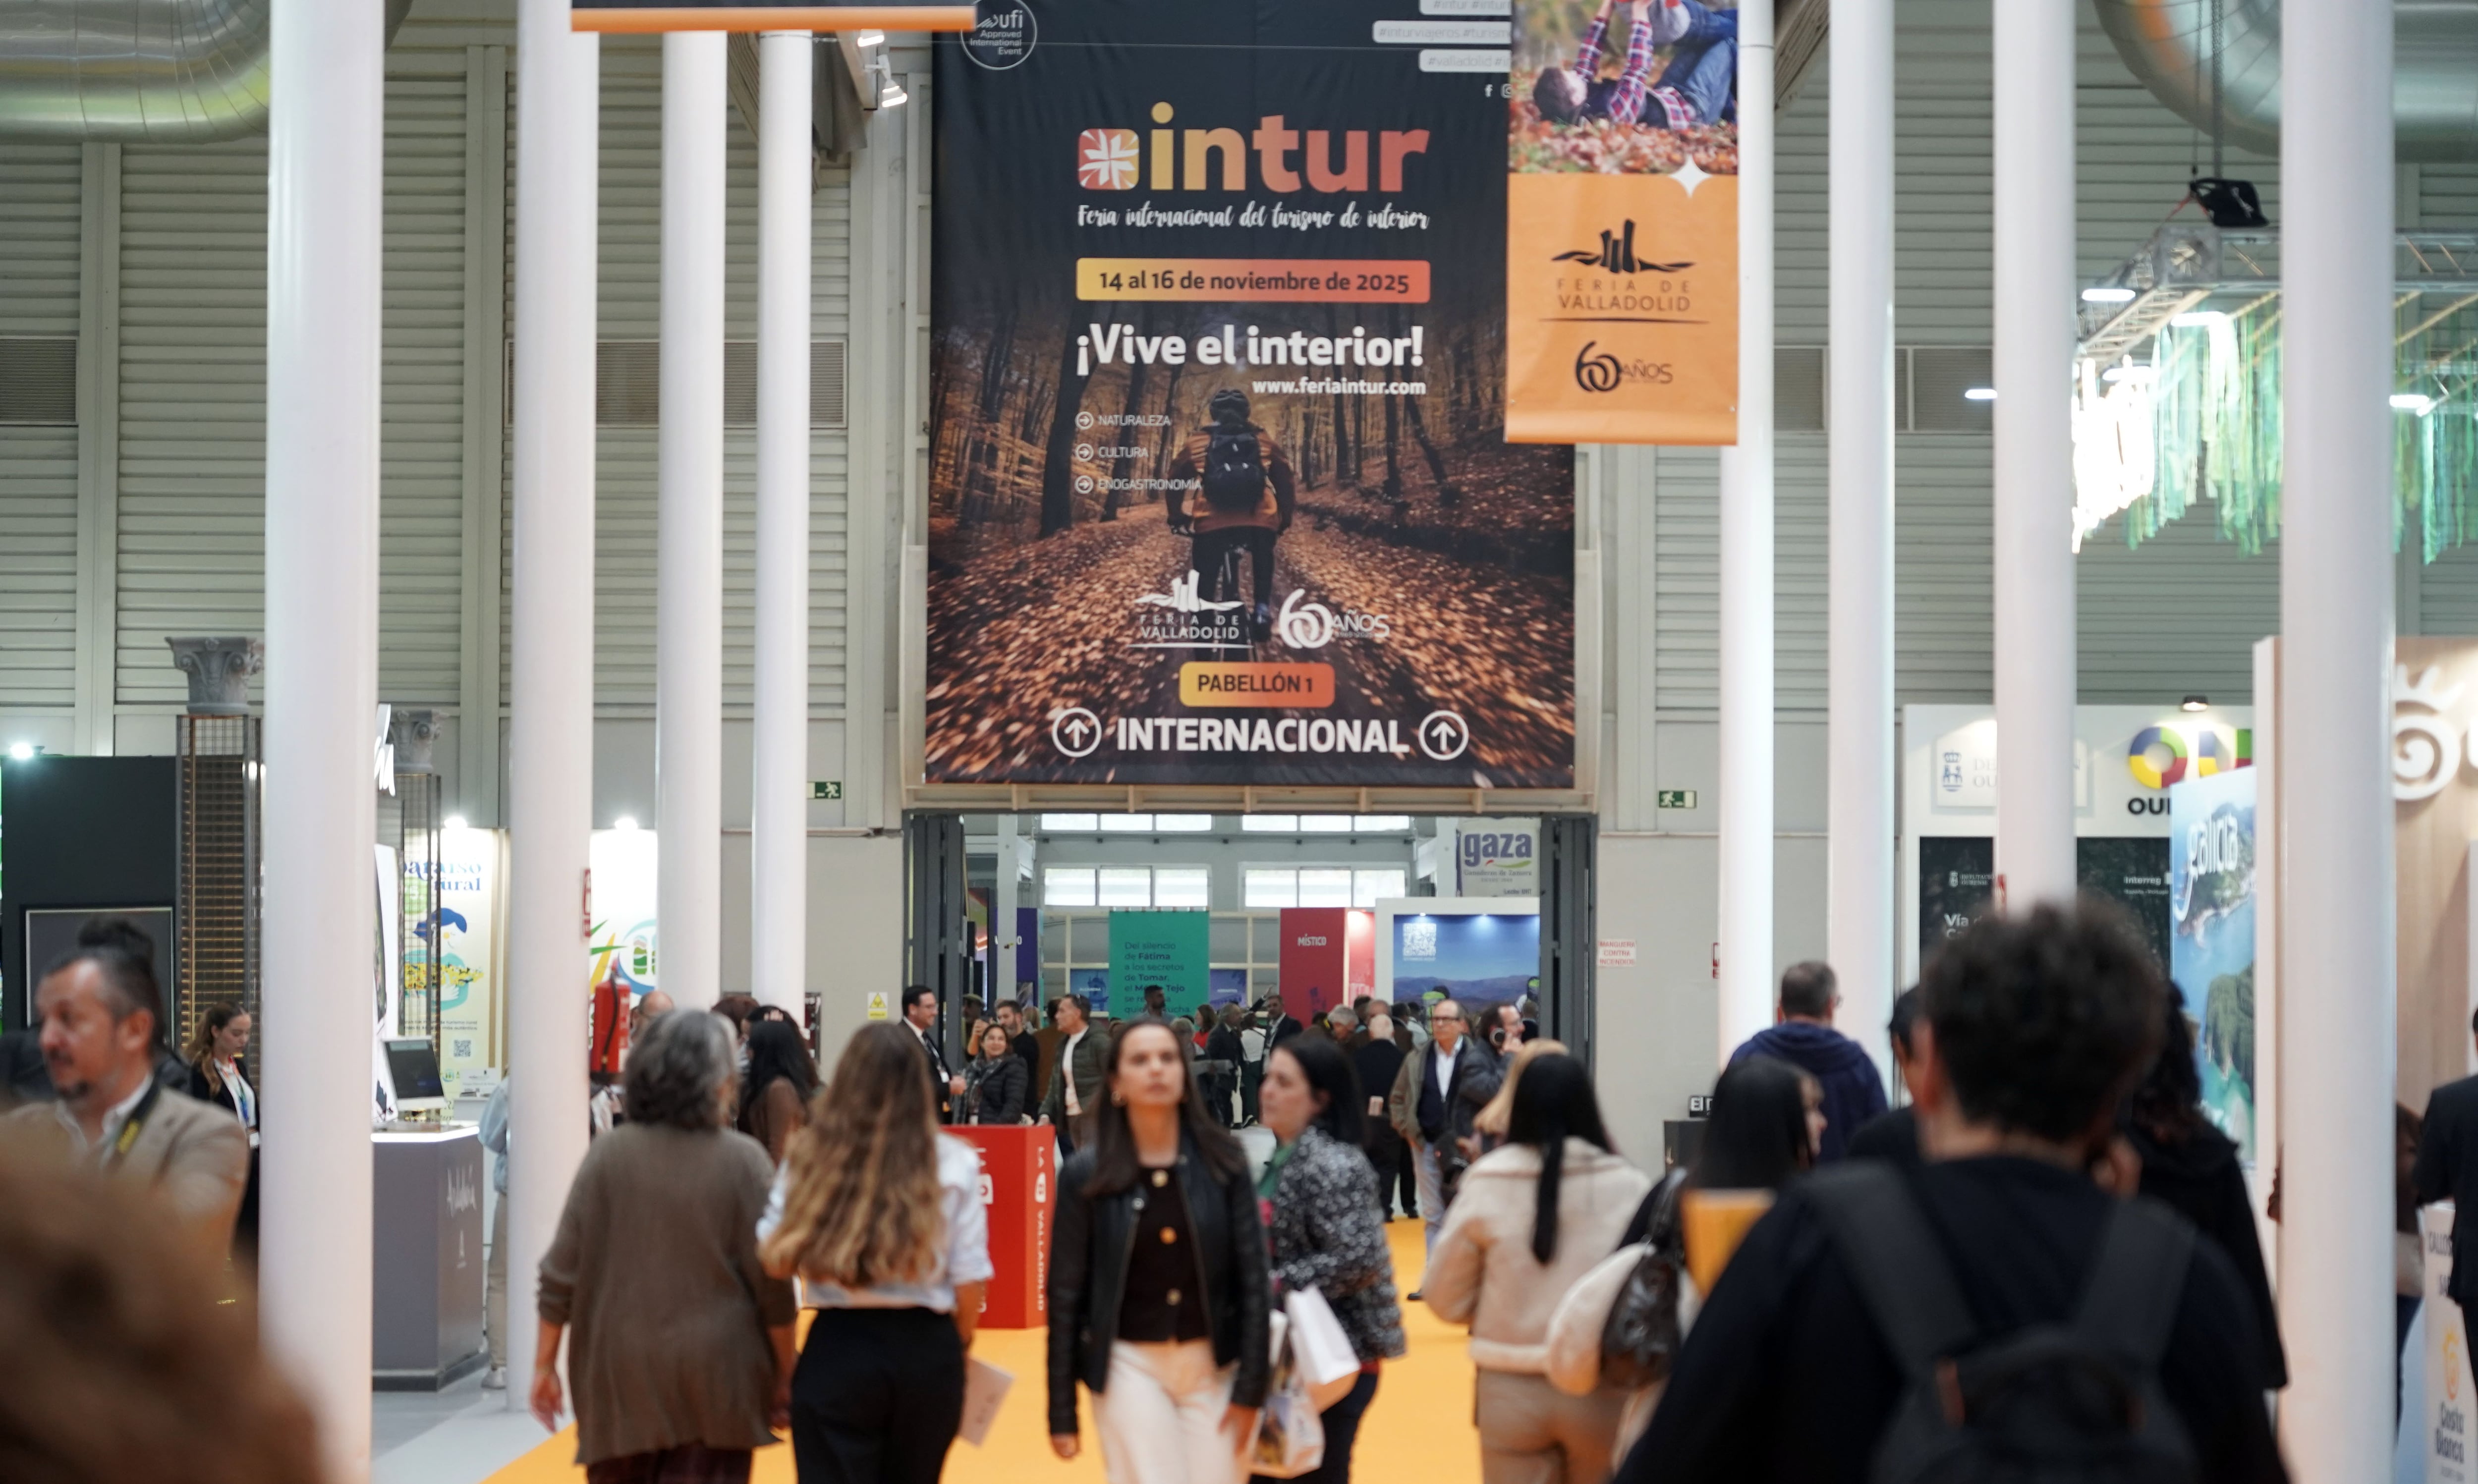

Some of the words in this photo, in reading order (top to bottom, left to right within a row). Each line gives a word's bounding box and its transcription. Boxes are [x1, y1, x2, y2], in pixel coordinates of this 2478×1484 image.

[999, 10, 1023, 28] ufi
[980, 30, 1022, 39] Approved
[1464, 27, 1511, 38] #turism
[970, 38, 1022, 47] International
[998, 47, 1022, 55] Event
[1150, 102, 1430, 193] intur
[1077, 205, 1118, 227] Feria
[1126, 202, 1233, 228] internacional
[1239, 201, 1267, 228] del
[1272, 201, 1333, 231] turismo
[1340, 201, 1361, 228] de
[1366, 202, 1430, 230] interior
[1100, 272, 1123, 291] 14
[1128, 271, 1146, 289] al
[1152, 271, 1174, 289] 16
[1180, 271, 1204, 289] de
[1210, 272, 1321, 291] noviembre
[1326, 273, 1351, 291] de
[1356, 275, 1409, 294] 2025
[1557, 278, 1636, 292] FERIA
[1660, 280, 1690, 293] DE
[1559, 295, 1690, 312] VALLADOLID
[1076, 323, 1186, 377] ¡Vive
[1196, 324, 1237, 366] el
[1246, 325, 1424, 367] interior!
[1575, 340, 1622, 392] 60
[1621, 359, 1673, 385] AÑOS
[1252, 377, 1426, 395] www.feriaintur.com
[1098, 415, 1171, 427] NATURALEZA
[1098, 447, 1149, 458] CULTURA
[1098, 476, 1202, 491] ENOGASTRONOMÍA
[1140, 614, 1200, 626] FERIA
[1217, 615, 1239, 626] DE
[1278, 588, 1333, 649] 60
[1332, 609, 1390, 638] AÑOS
[1141, 626, 1240, 640] VALLADOLID
[1198, 670, 1301, 693] PABELLÓN
[1306, 678, 1313, 693] 1
[1117, 717, 1410, 754] INTERNACIONAL
[2128, 797, 2170, 815] OU
[1464, 833, 1532, 867] gaza
[2124, 876, 2162, 886] Interreg
[1944, 913, 1970, 927] Vía
[1297, 934, 1327, 946] MÍSTICO
[1132, 963, 1145, 971] los
[1166, 985, 1185, 993] Tejo
[1690, 1097, 1704, 1111] El
